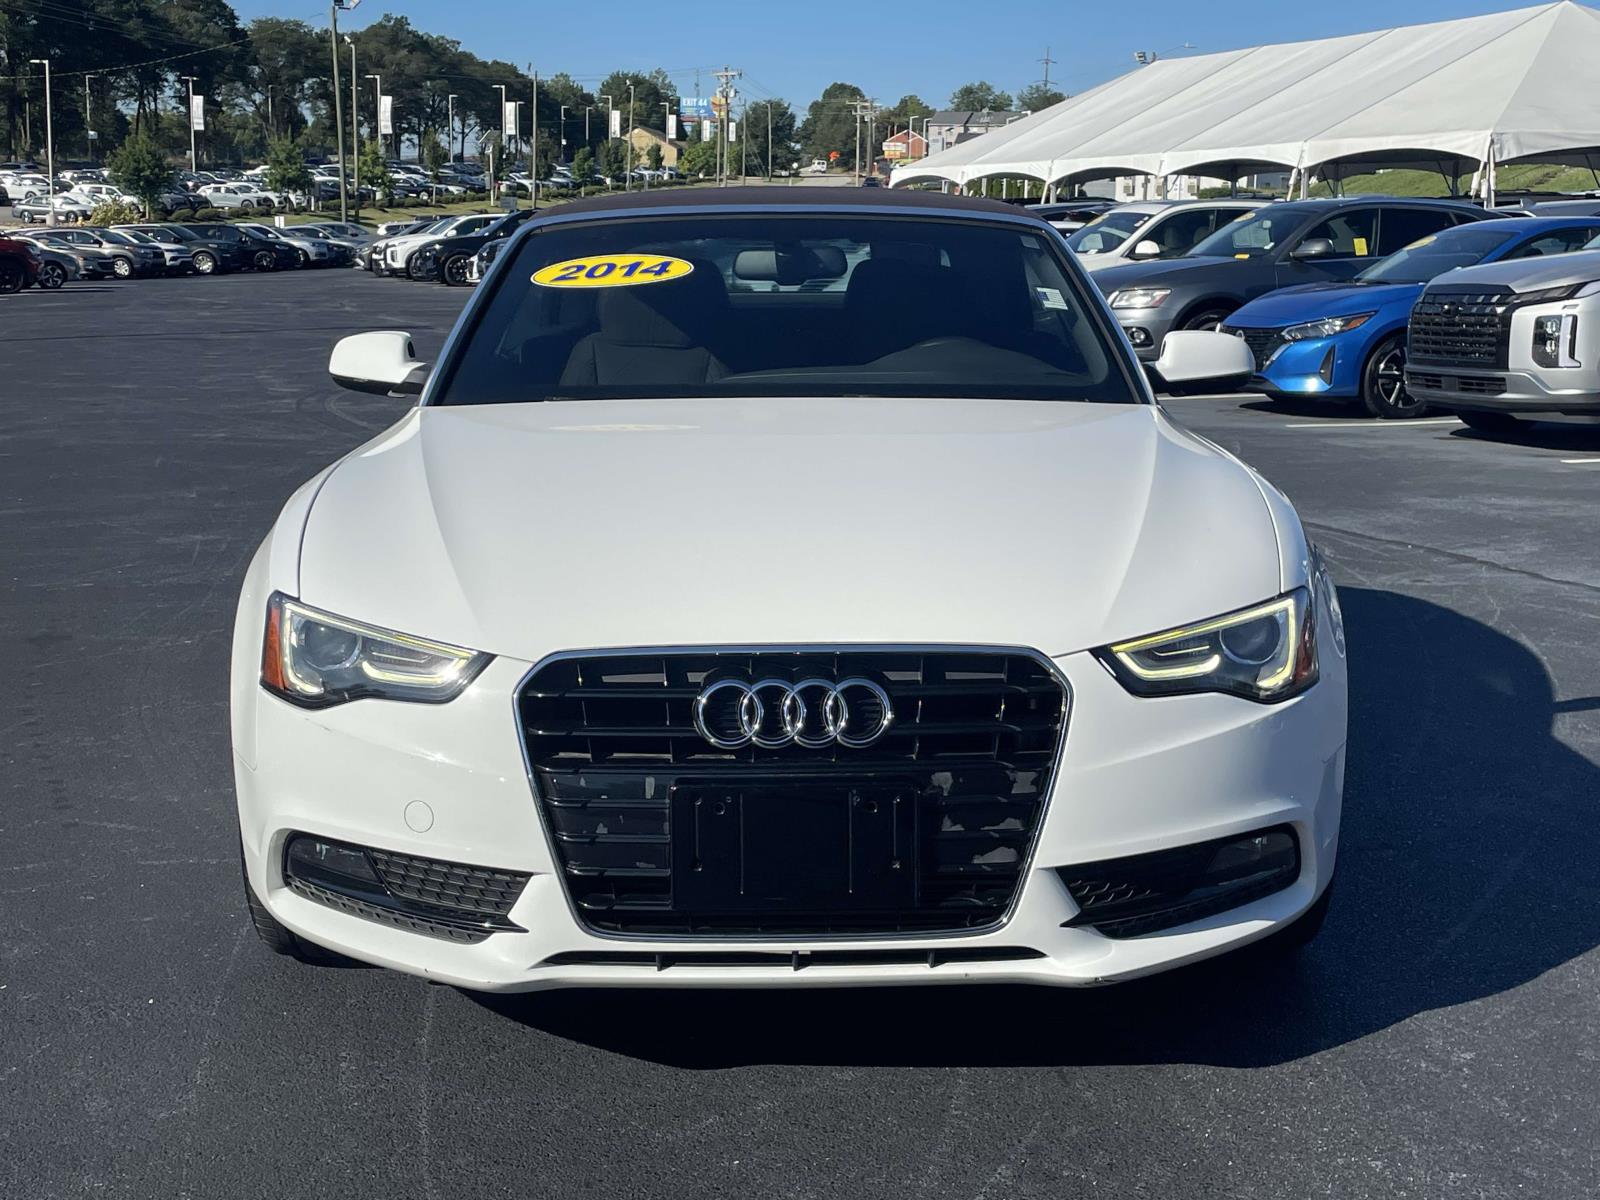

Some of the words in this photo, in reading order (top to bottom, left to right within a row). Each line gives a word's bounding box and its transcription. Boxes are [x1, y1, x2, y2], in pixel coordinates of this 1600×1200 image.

[683, 97, 697, 106] EXIT
[698, 97, 708, 106] 44
[550, 260, 673, 282] 2014
